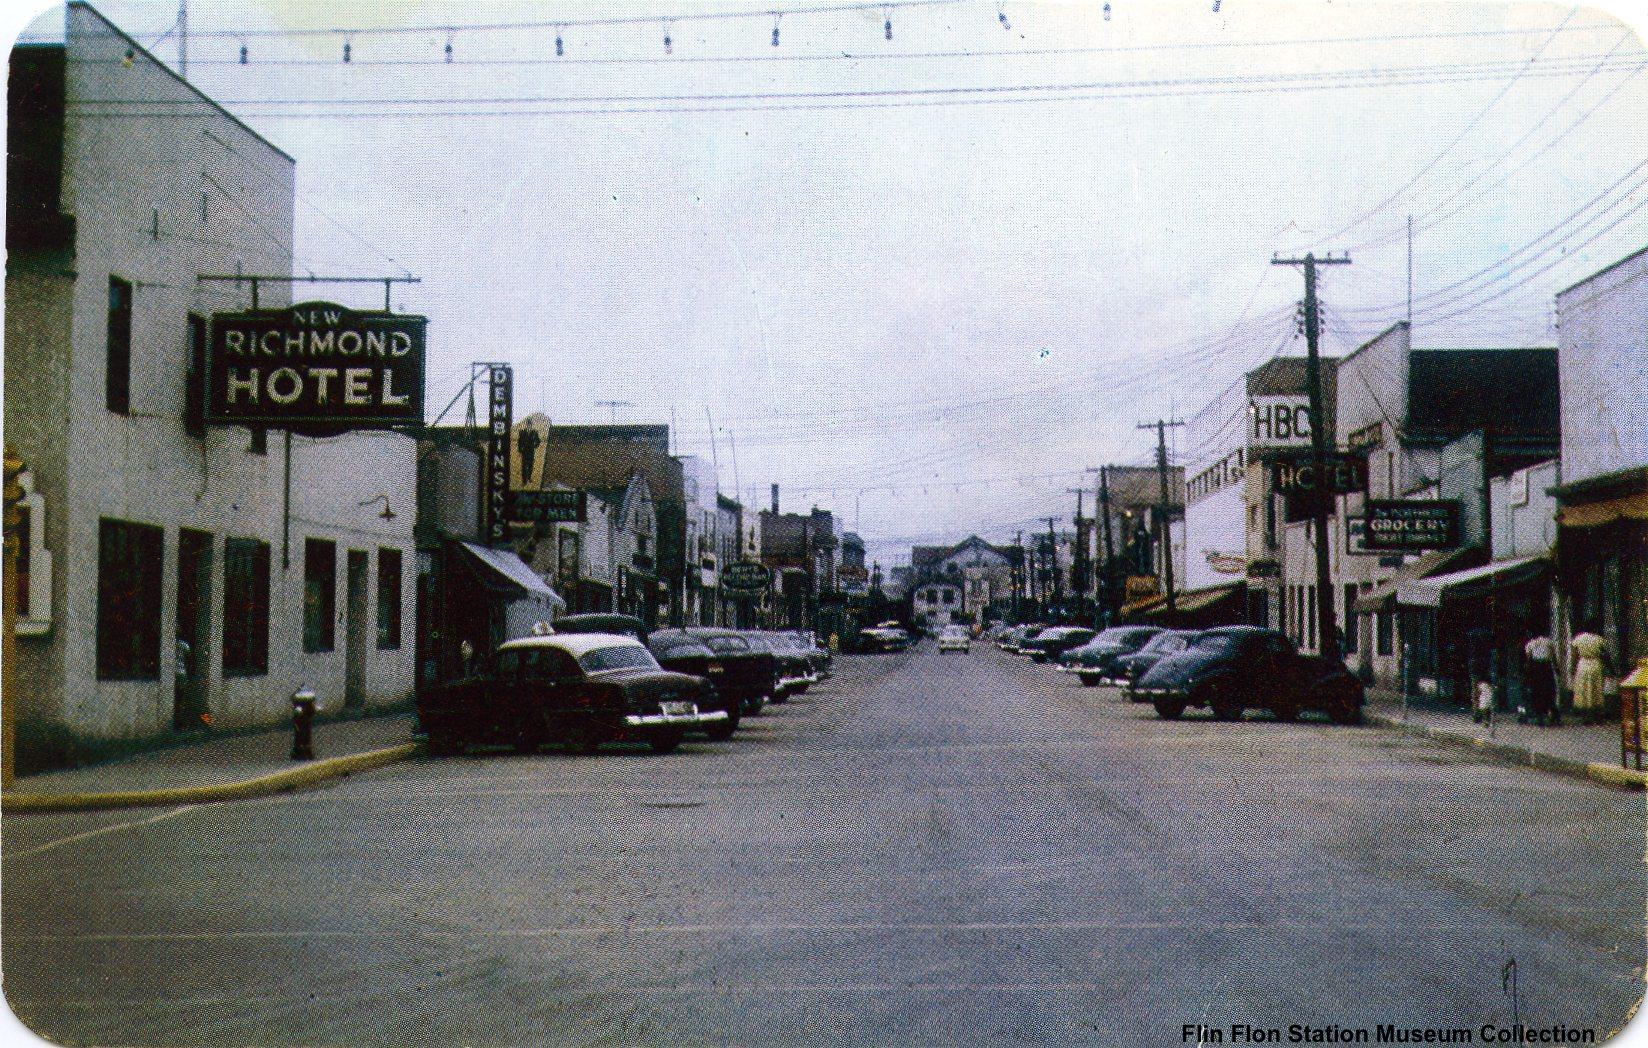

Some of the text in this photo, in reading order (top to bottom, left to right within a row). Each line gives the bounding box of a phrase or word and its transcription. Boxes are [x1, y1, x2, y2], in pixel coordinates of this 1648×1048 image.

[294, 310, 342, 325] NEW
[225, 330, 412, 357] RICHMOND
[226, 367, 410, 405] HOTEL
[1253, 403, 1312, 440] HBC
[1369, 518, 1450, 531] GROCERY
